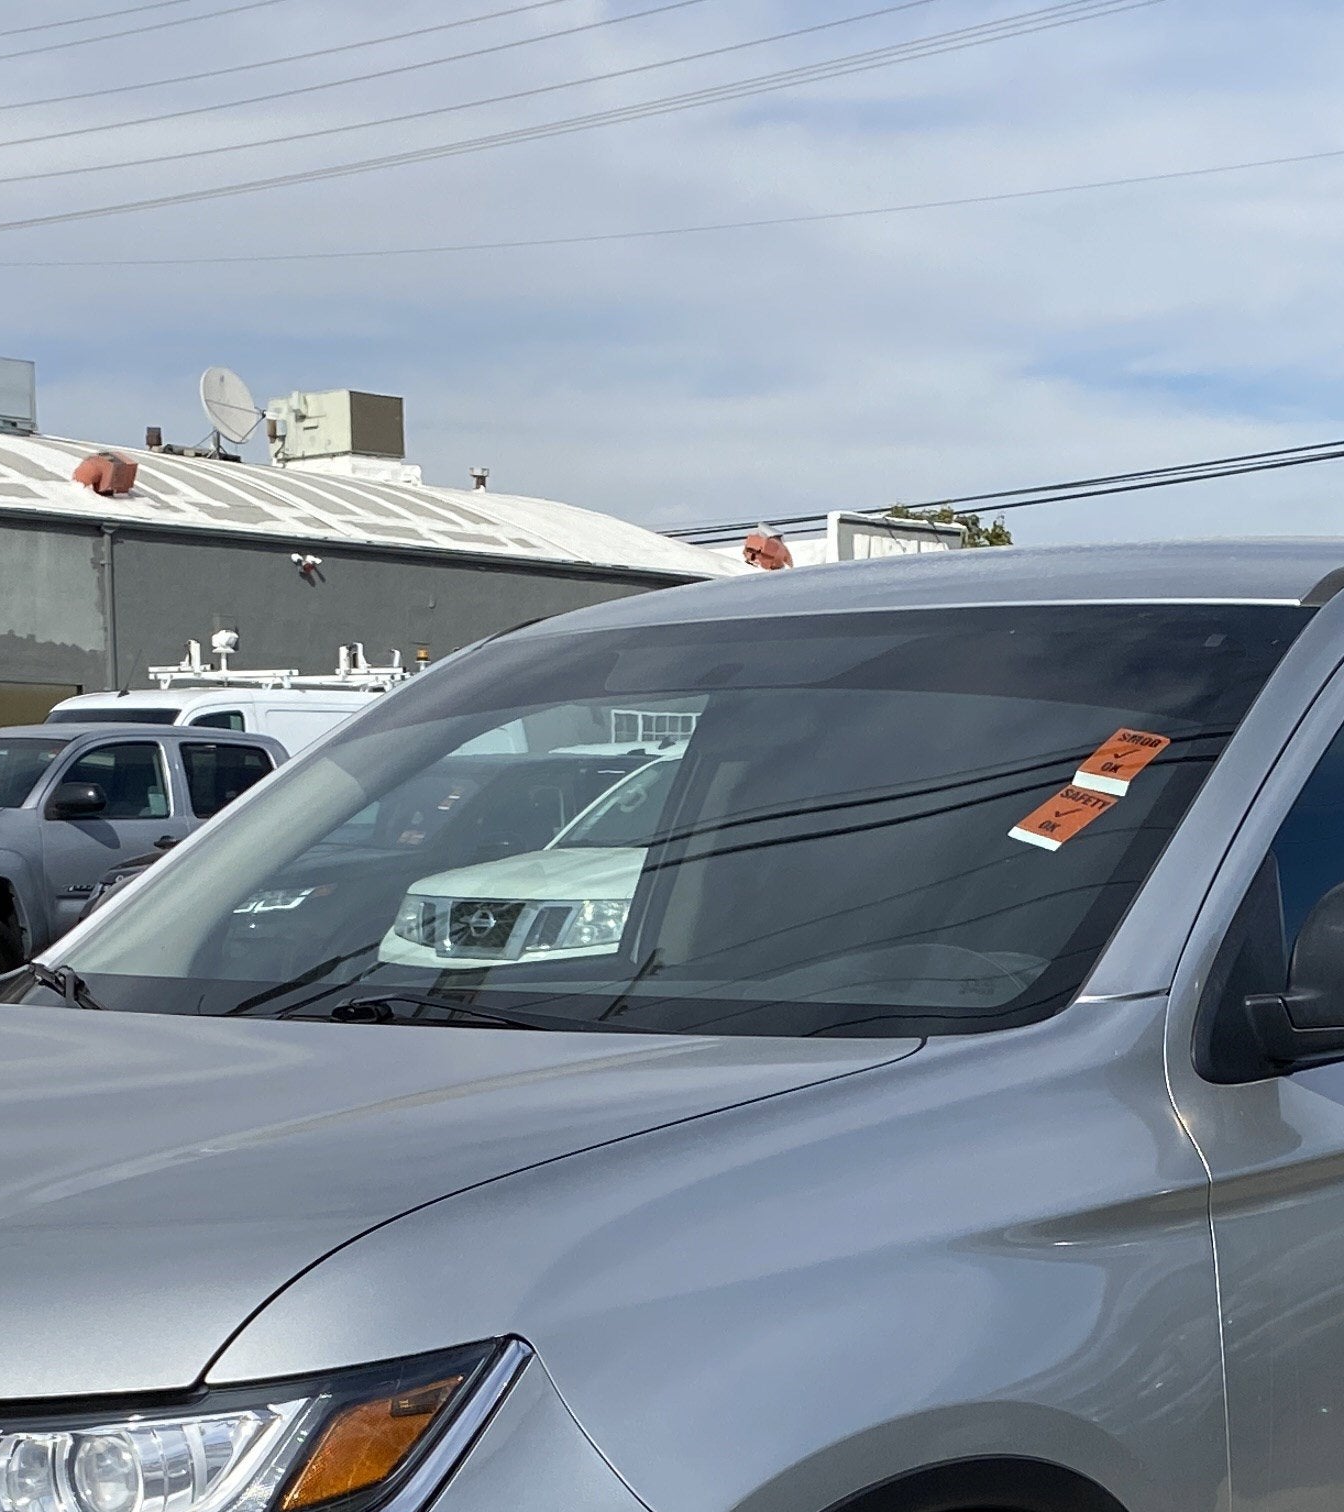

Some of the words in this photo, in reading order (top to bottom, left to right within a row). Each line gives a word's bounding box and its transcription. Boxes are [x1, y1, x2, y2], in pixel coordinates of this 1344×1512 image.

[1100, 762, 1124, 774] OK
[1060, 788, 1112, 811] SAFETY
[1038, 821, 1062, 833] OK
